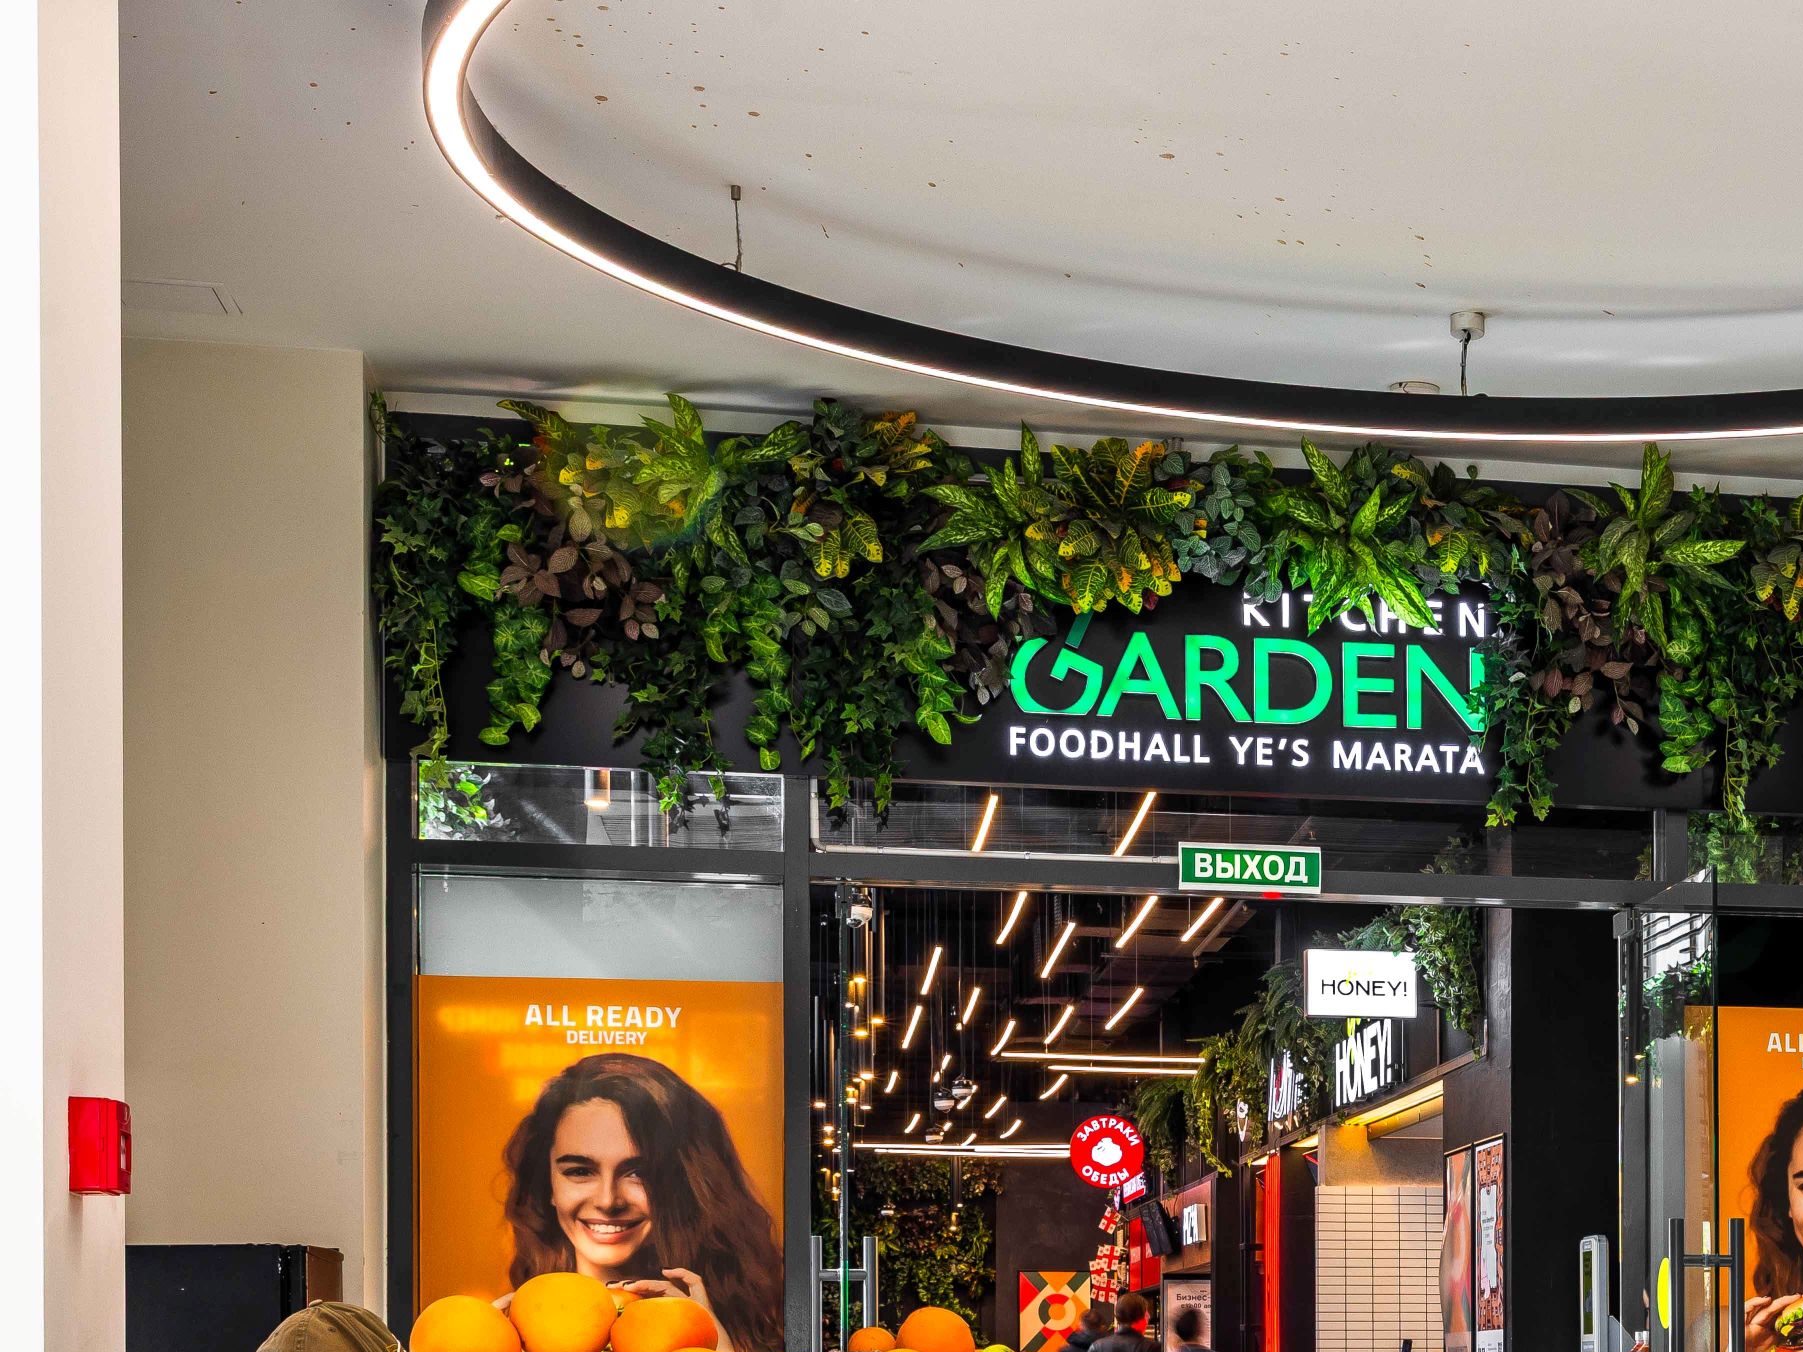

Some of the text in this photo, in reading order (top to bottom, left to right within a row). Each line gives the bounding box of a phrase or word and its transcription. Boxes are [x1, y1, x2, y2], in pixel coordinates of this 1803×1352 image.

[1242, 591, 1486, 638] KICHEN
[1010, 630, 1486, 733] GARDEN
[1009, 725, 1485, 775] FOODHALL YE'S MARATA
[1194, 852, 1309, 884] ВЫХОД
[1321, 979, 1407, 996] HONEY!
[525, 1004, 682, 1028] ALL READY
[566, 1030, 648, 1045] DELIVERY
[1335, 1018, 1392, 1107] HONEY!
[1077, 1117, 1141, 1147] ЗАВТРАКИ
[1081, 1165, 1130, 1187] ОБЕДЫ
